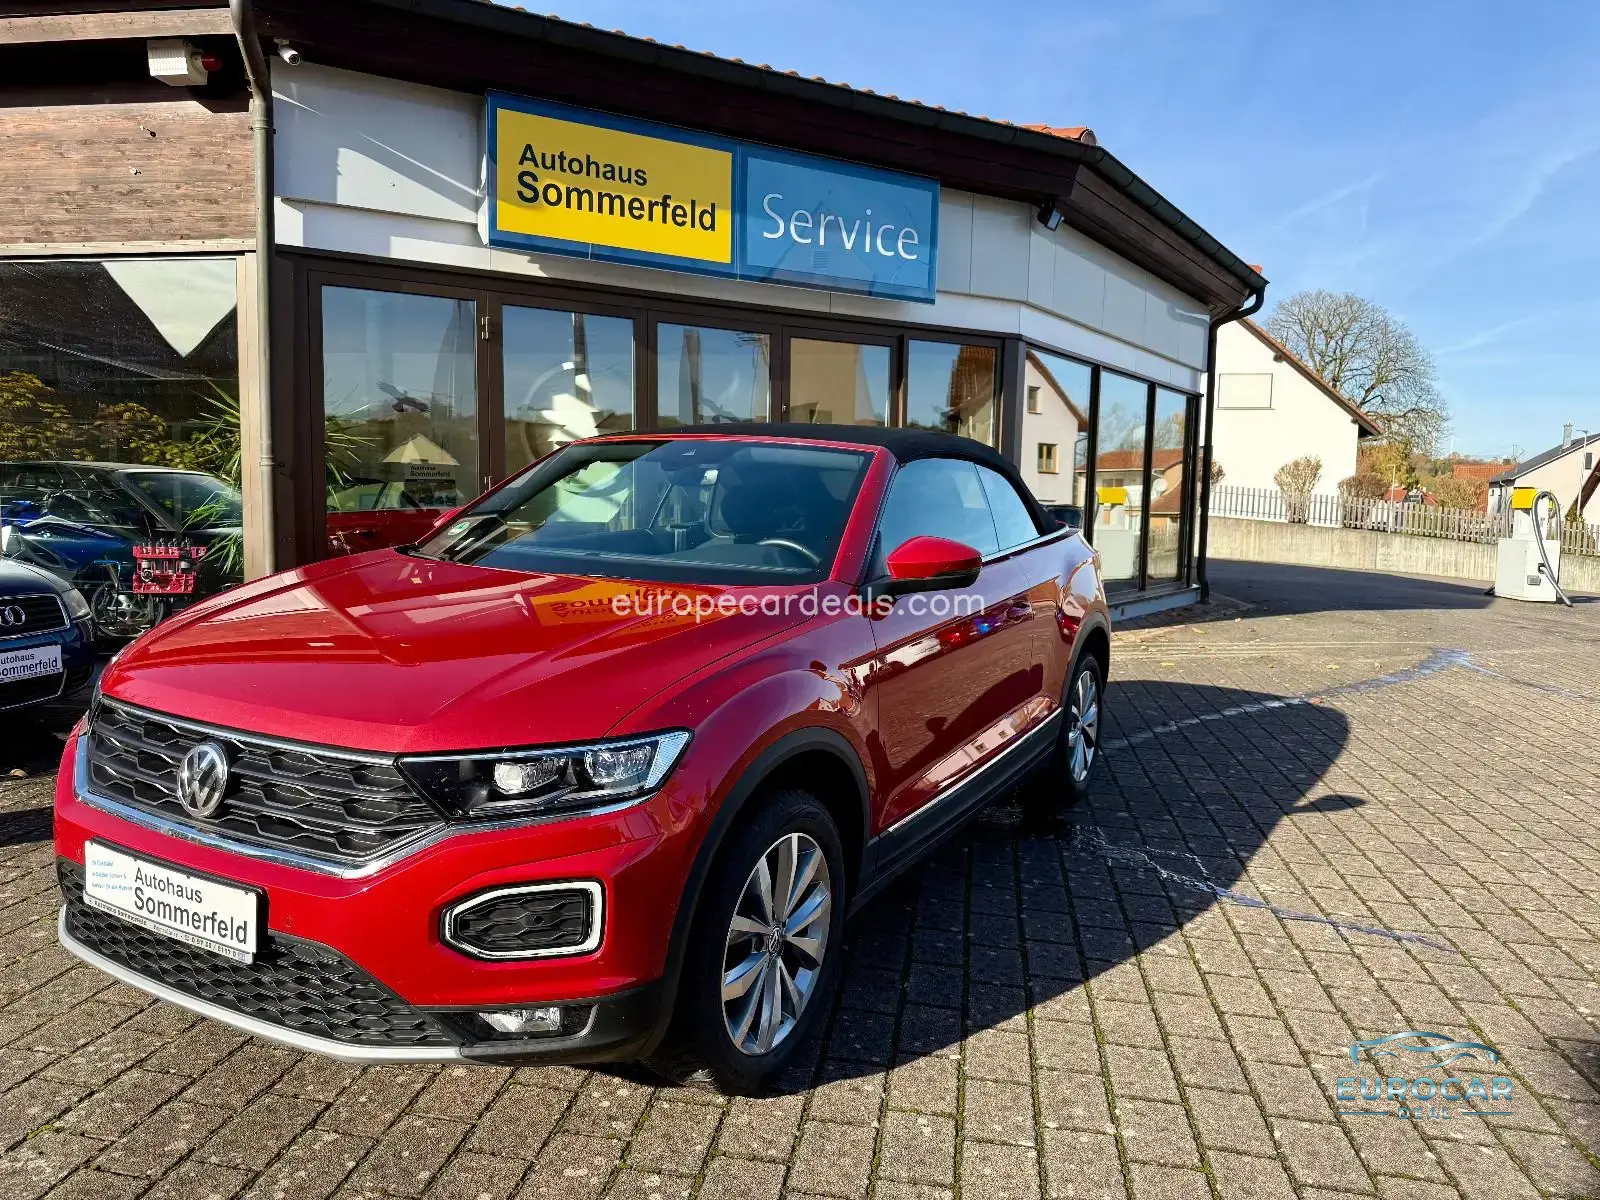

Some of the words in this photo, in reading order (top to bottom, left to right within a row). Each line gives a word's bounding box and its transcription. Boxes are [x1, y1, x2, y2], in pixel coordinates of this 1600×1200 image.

[518, 143, 648, 187] Autohaus
[516, 170, 716, 232] Sommerfeld
[762, 193, 919, 260] Service
[0, 653, 35, 665] utohaus
[0, 657, 58, 677] ommerfeld
[134, 867, 203, 903] Autohaus
[134, 886, 248, 945] Sommerfeld
